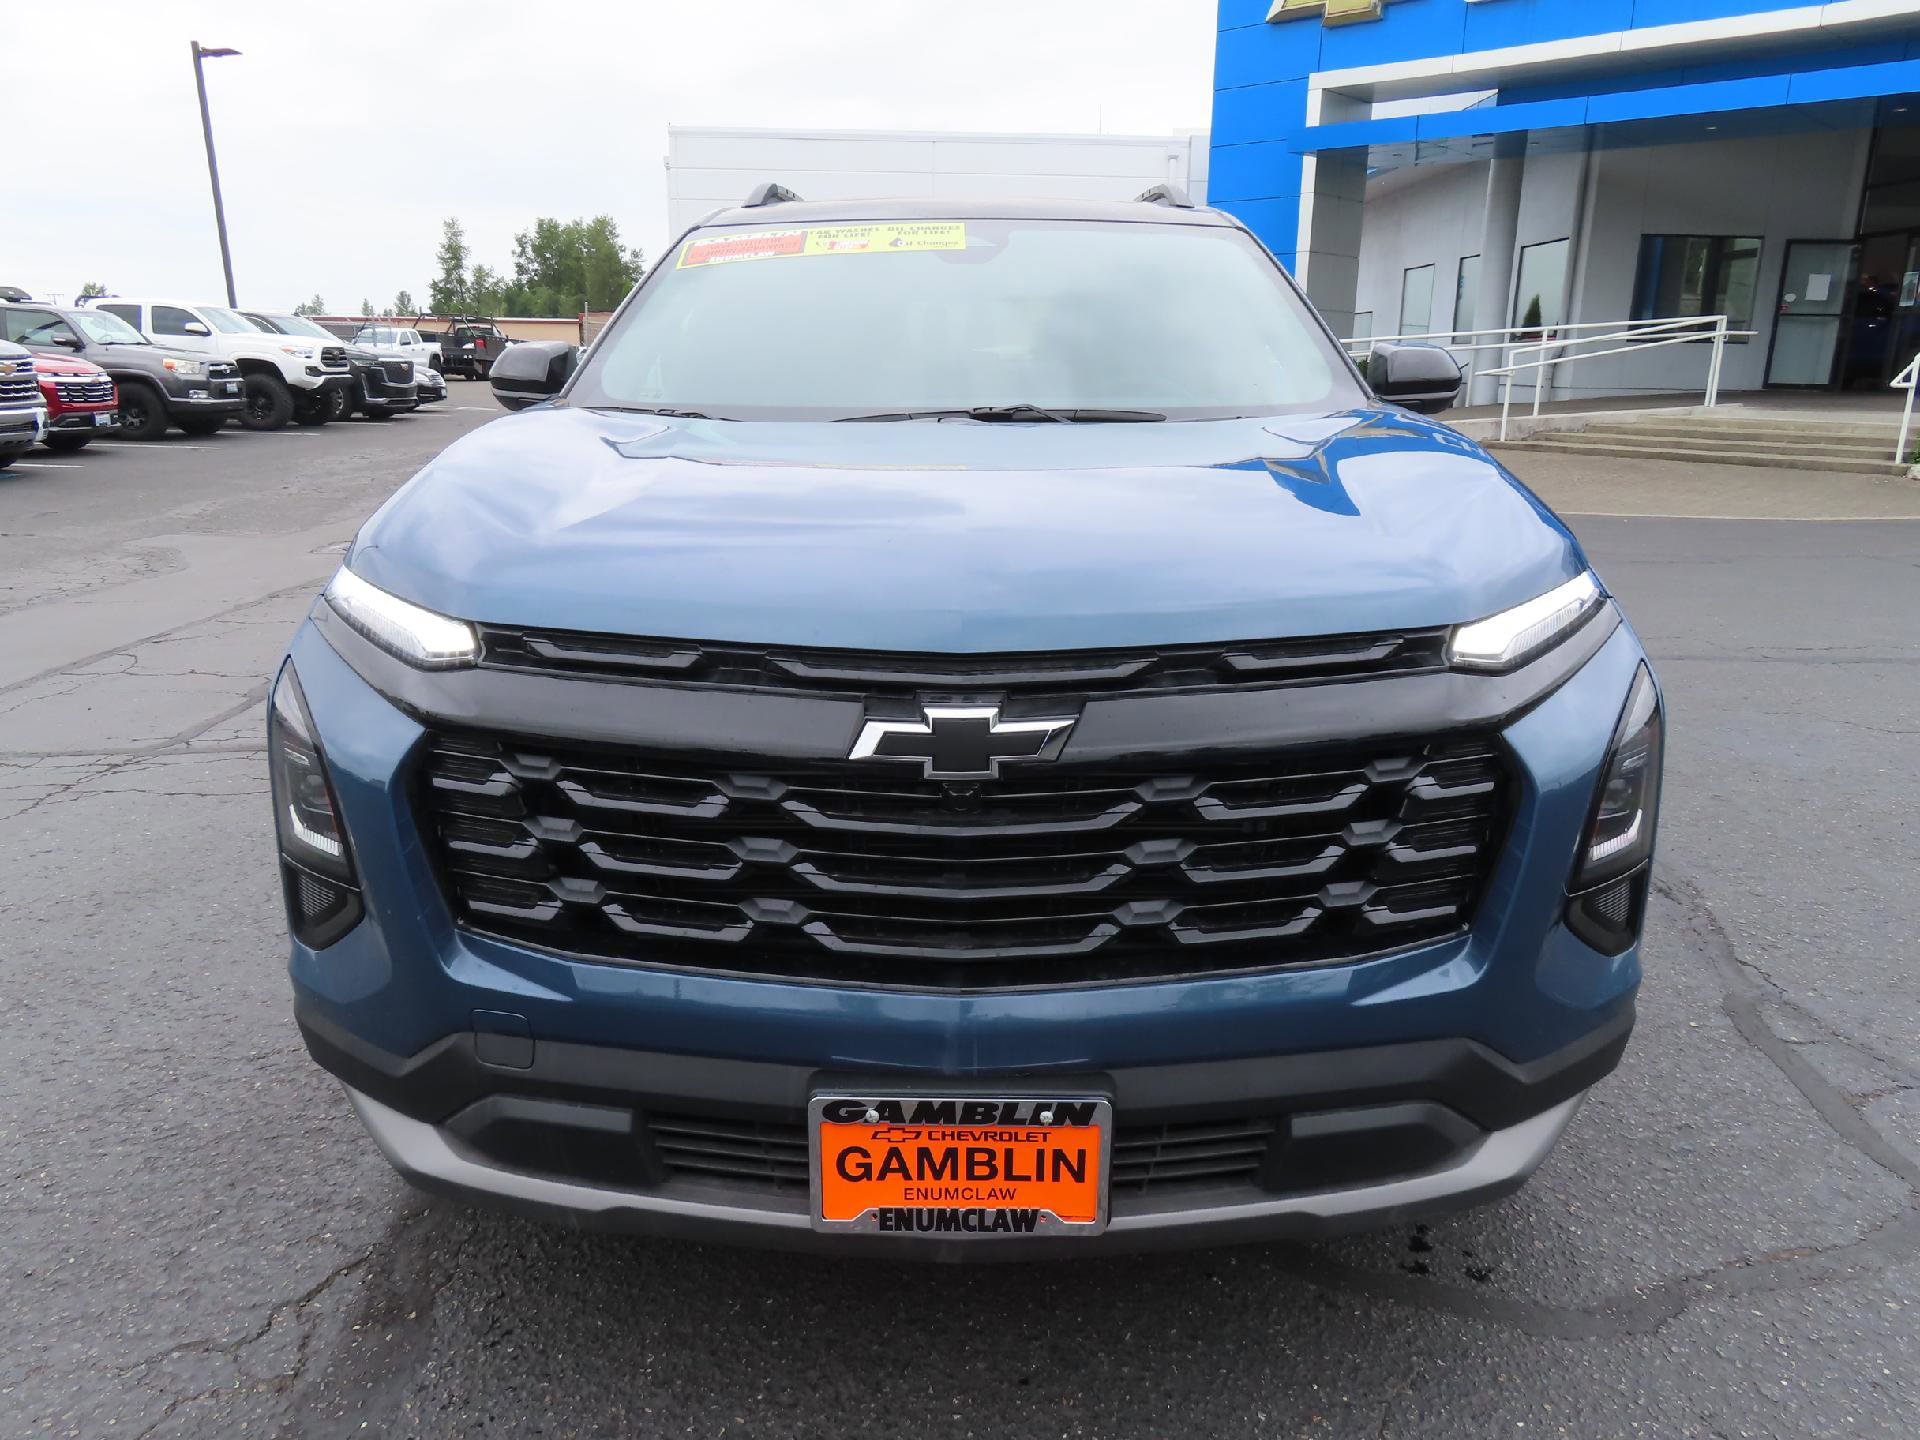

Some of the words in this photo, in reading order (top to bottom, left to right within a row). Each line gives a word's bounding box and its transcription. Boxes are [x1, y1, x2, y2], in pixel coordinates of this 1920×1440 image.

[821, 1099, 1098, 1127] GAMBLIN
[927, 1129, 1052, 1143] CHEVROLET
[835, 1145, 1087, 1184] GAMBLIN
[903, 1187, 1017, 1201] ENUMCLAW
[878, 1207, 1040, 1233] ENUMCLAW
